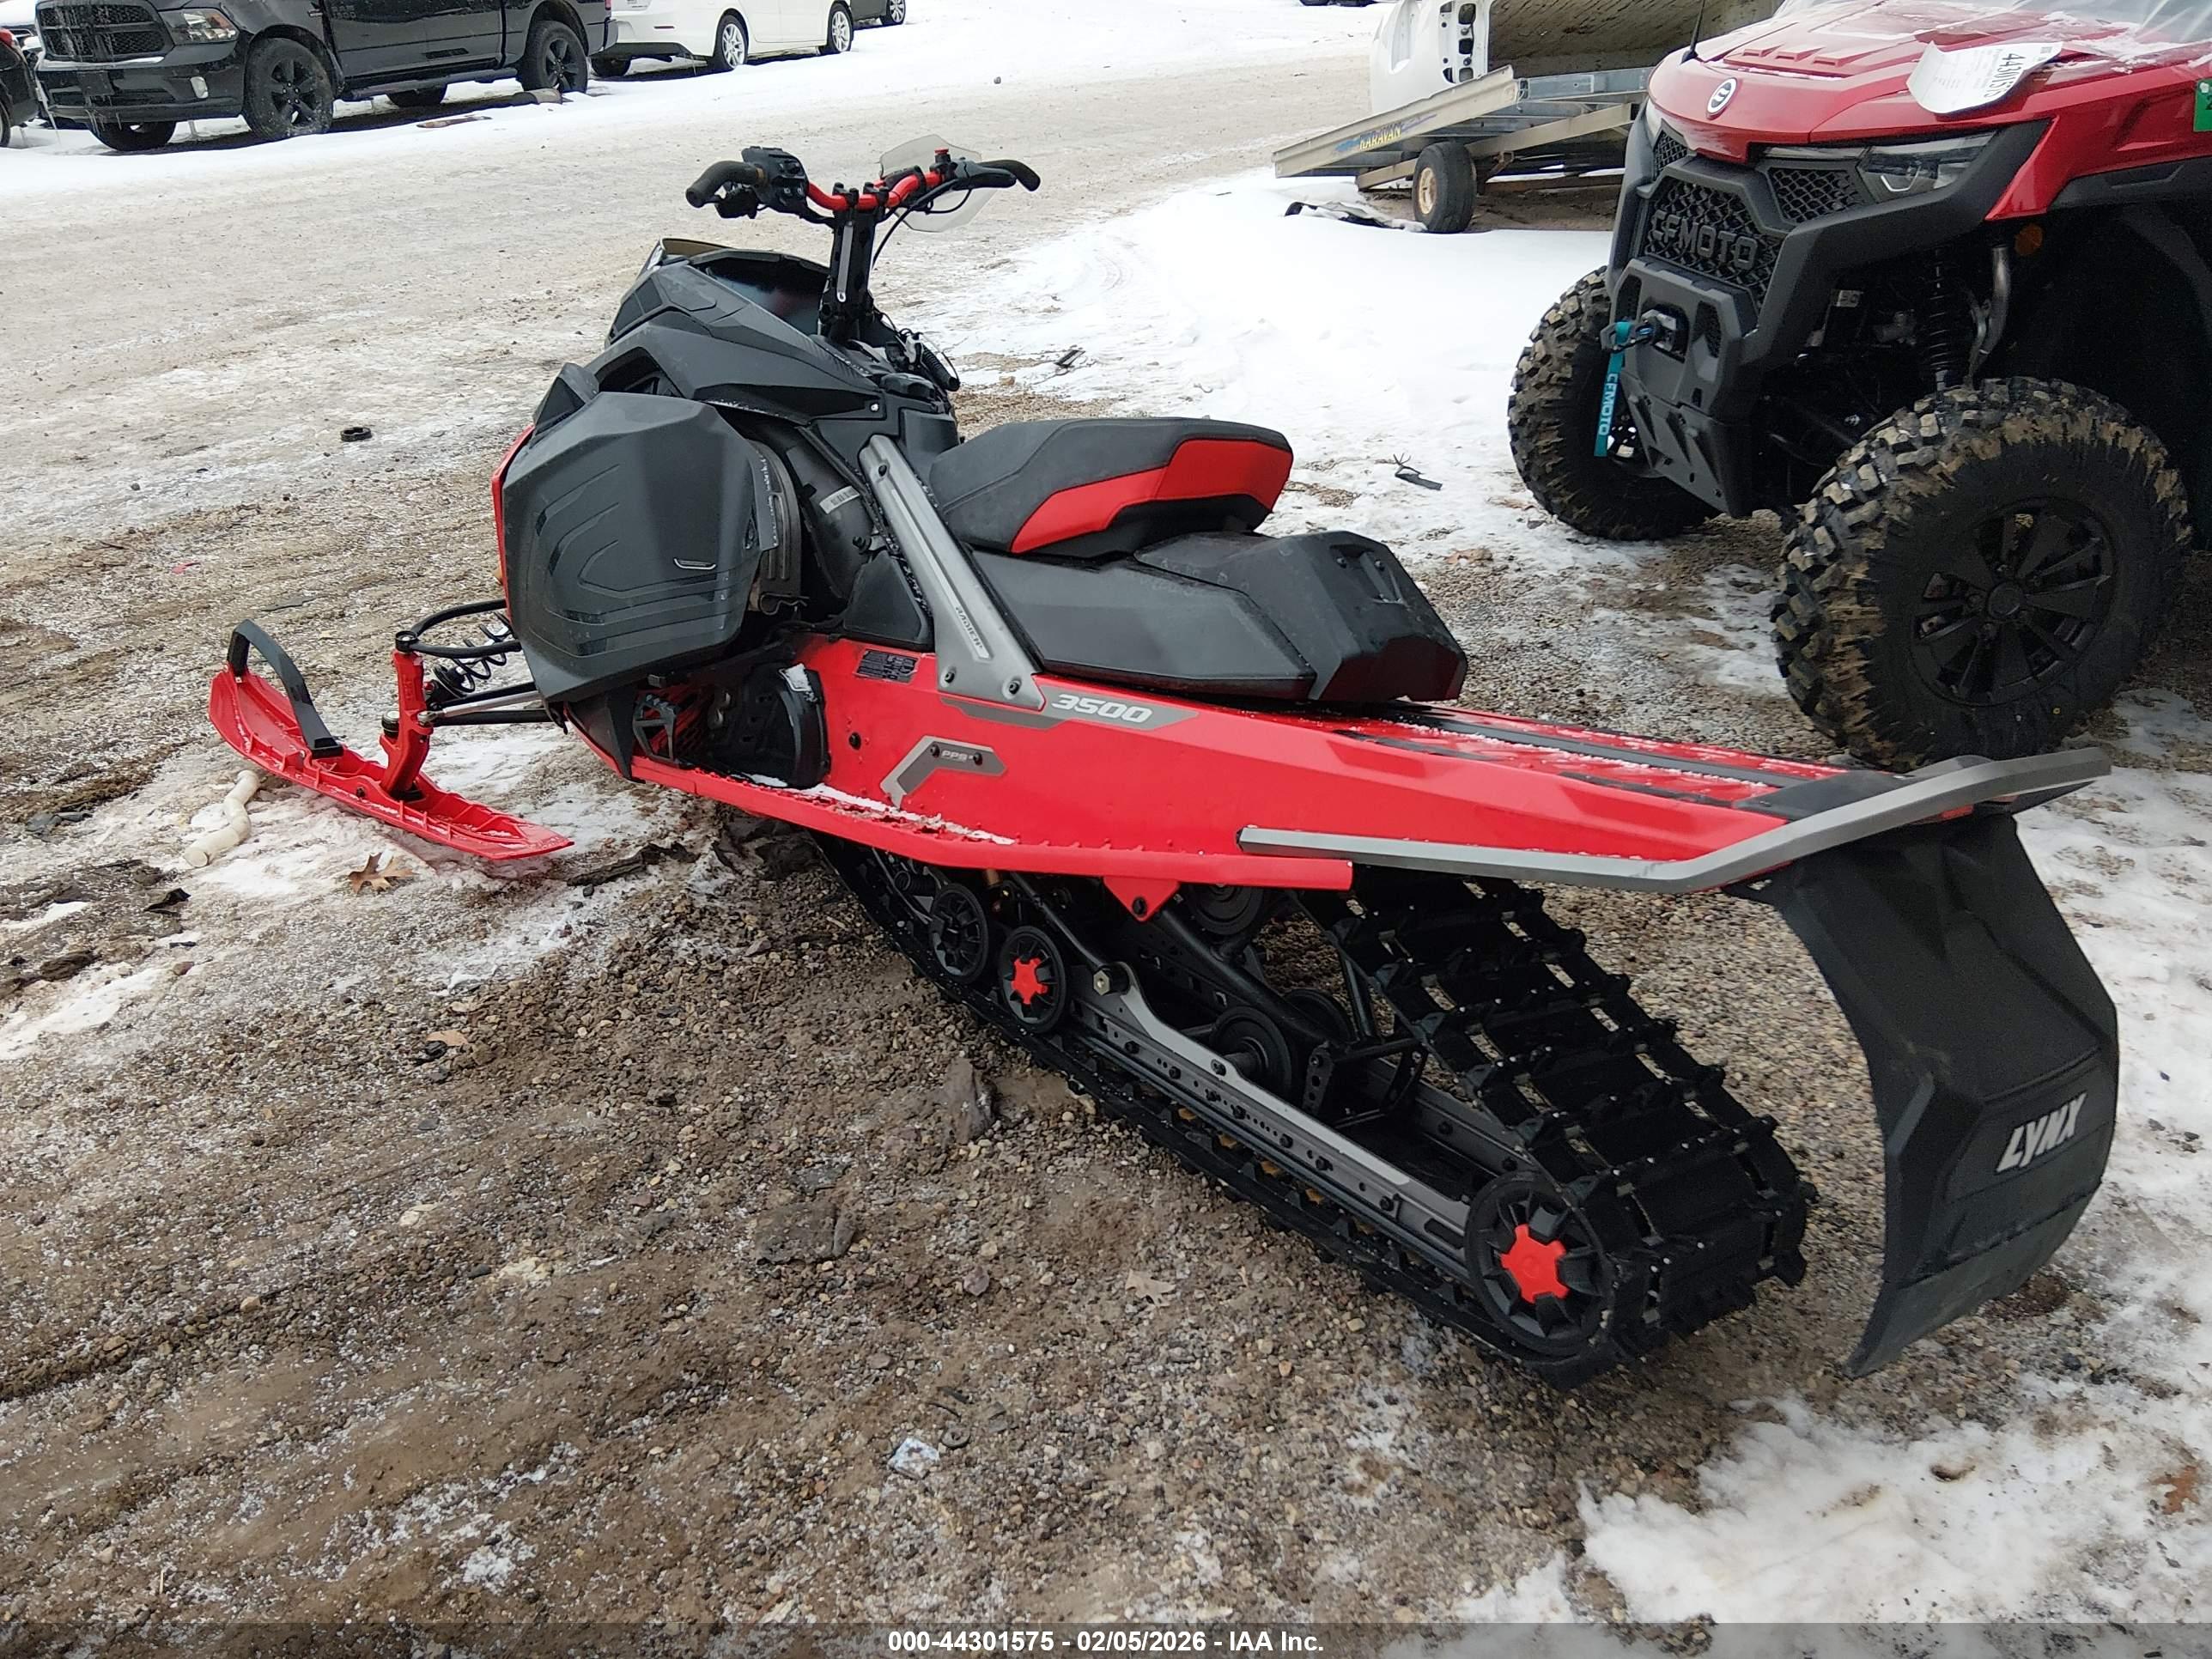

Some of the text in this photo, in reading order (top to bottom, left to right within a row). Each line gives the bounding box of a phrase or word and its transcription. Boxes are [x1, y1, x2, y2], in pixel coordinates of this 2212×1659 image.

[1650, 209, 1759, 271] CFMOTO
[1599, 373, 1619, 436] CFMOTO
[1051, 693, 1153, 724] 3500
[1996, 1091, 2088, 1174] LYNX
